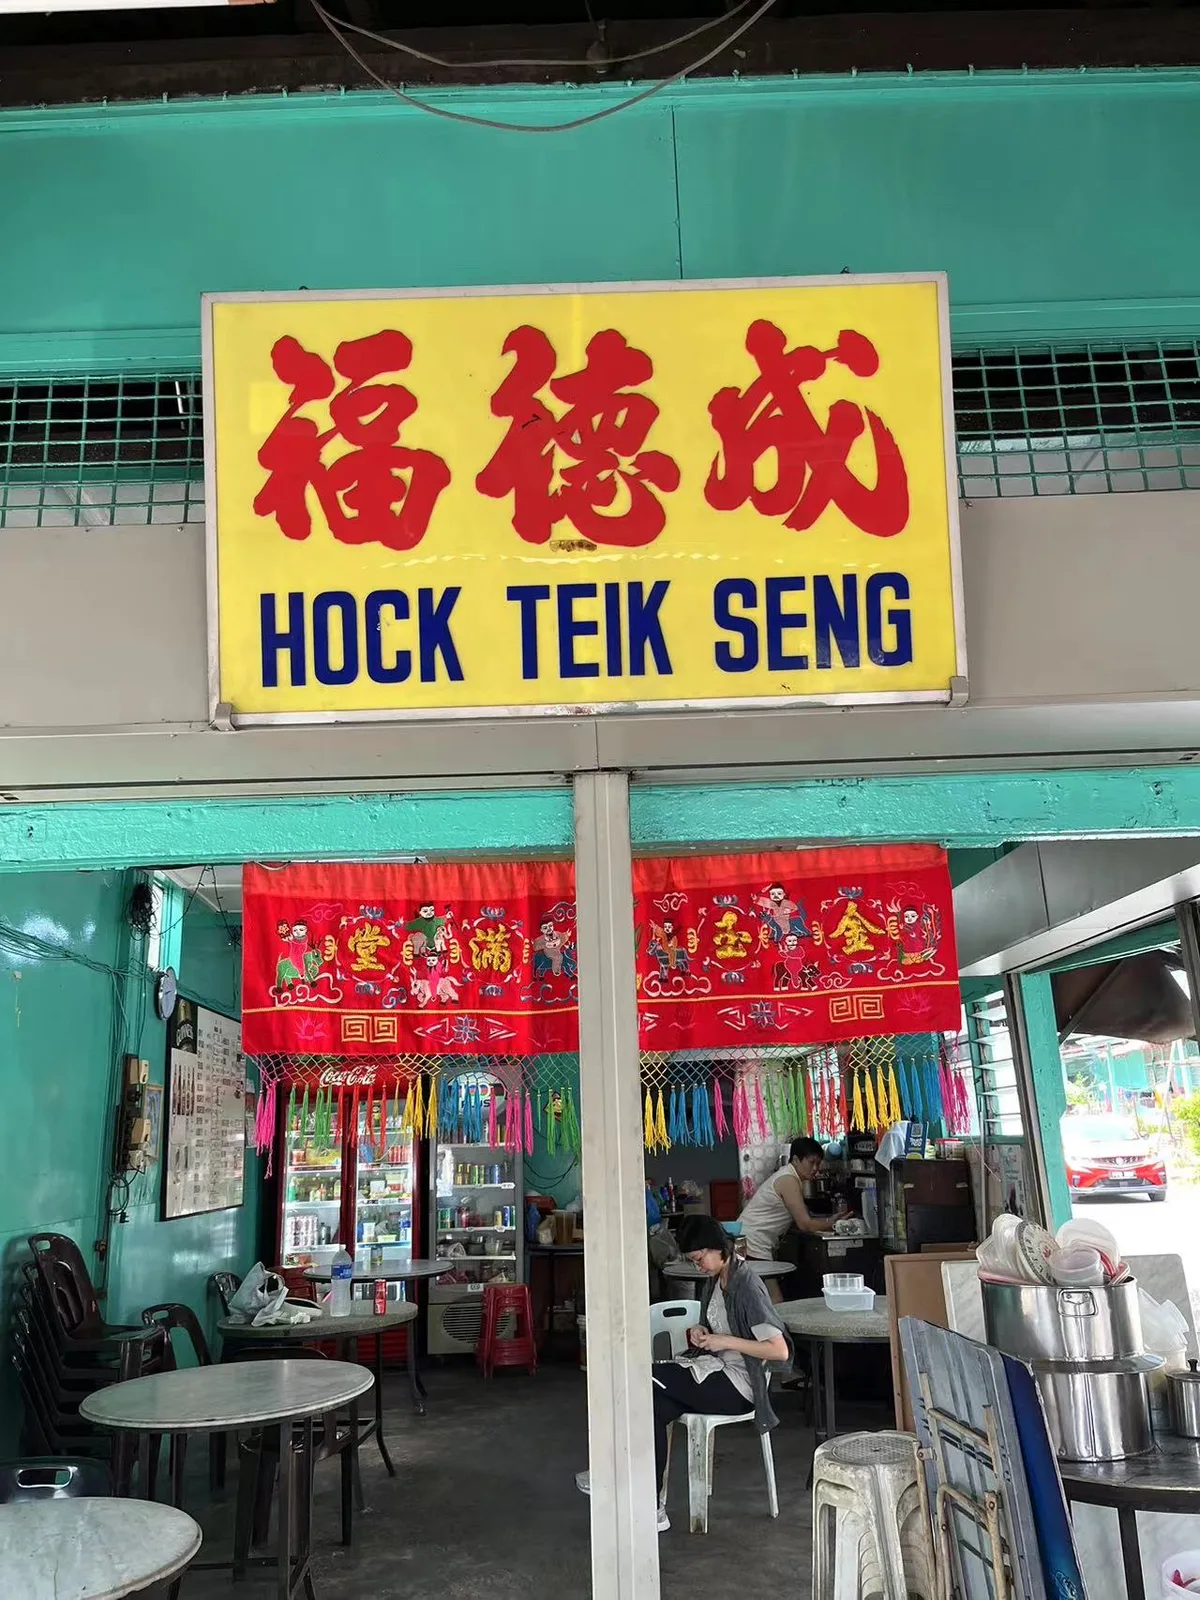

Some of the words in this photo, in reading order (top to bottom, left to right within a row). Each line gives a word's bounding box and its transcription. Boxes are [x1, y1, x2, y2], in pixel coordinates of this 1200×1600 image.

[261, 585, 464, 687] HOCK
[506, 580, 673, 679] TEIK
[714, 572, 913, 672] SENG
[348, 923, 390, 972] 堂
[830, 901, 886, 955] 金
